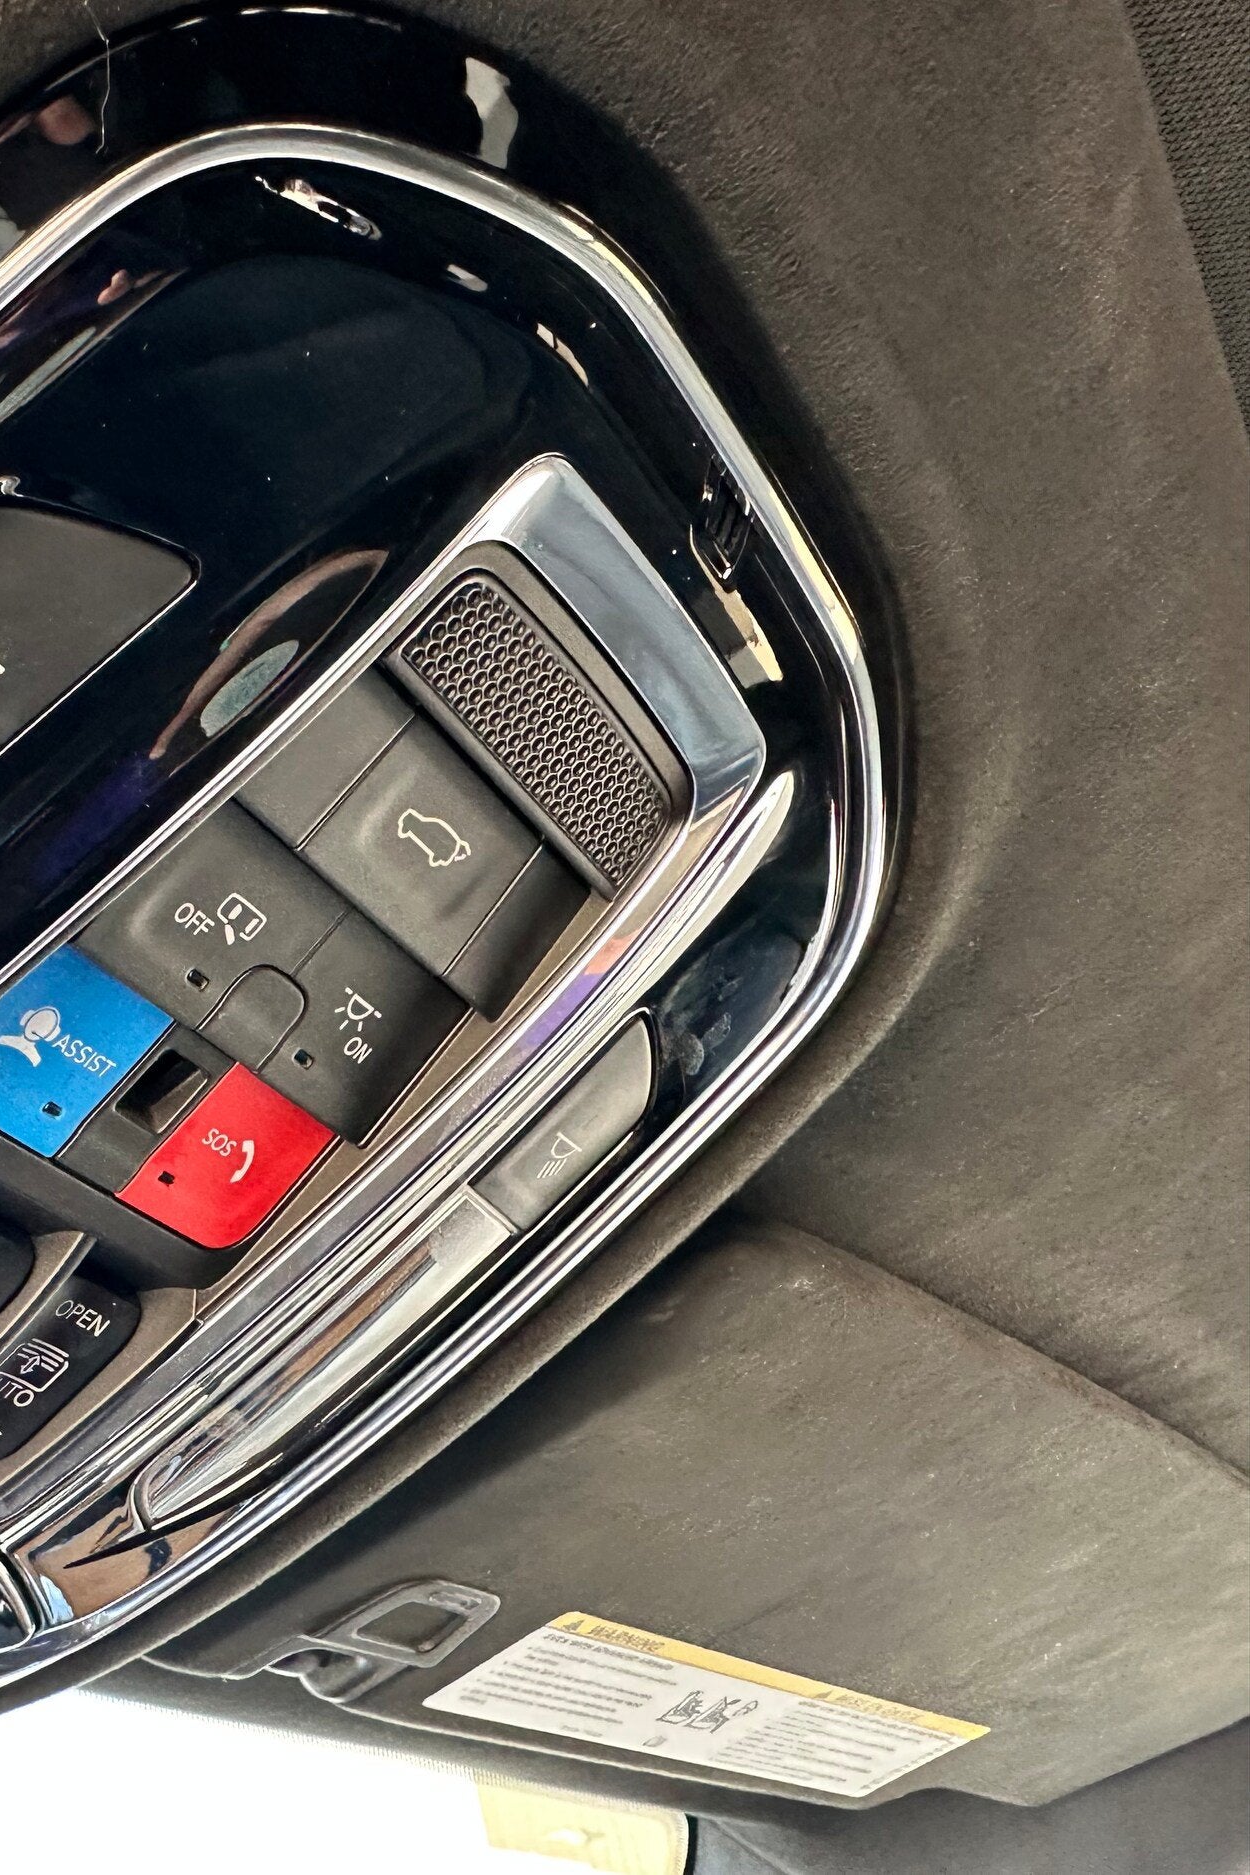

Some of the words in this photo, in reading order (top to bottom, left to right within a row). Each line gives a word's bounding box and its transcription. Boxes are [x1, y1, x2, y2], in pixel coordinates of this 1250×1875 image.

[173, 902, 215, 936] OFF
[54, 1033, 117, 1077] ASSIST
[343, 1036, 372, 1064] ON
[201, 1127, 238, 1157] SOS
[54, 1299, 111, 1338] OPEN
